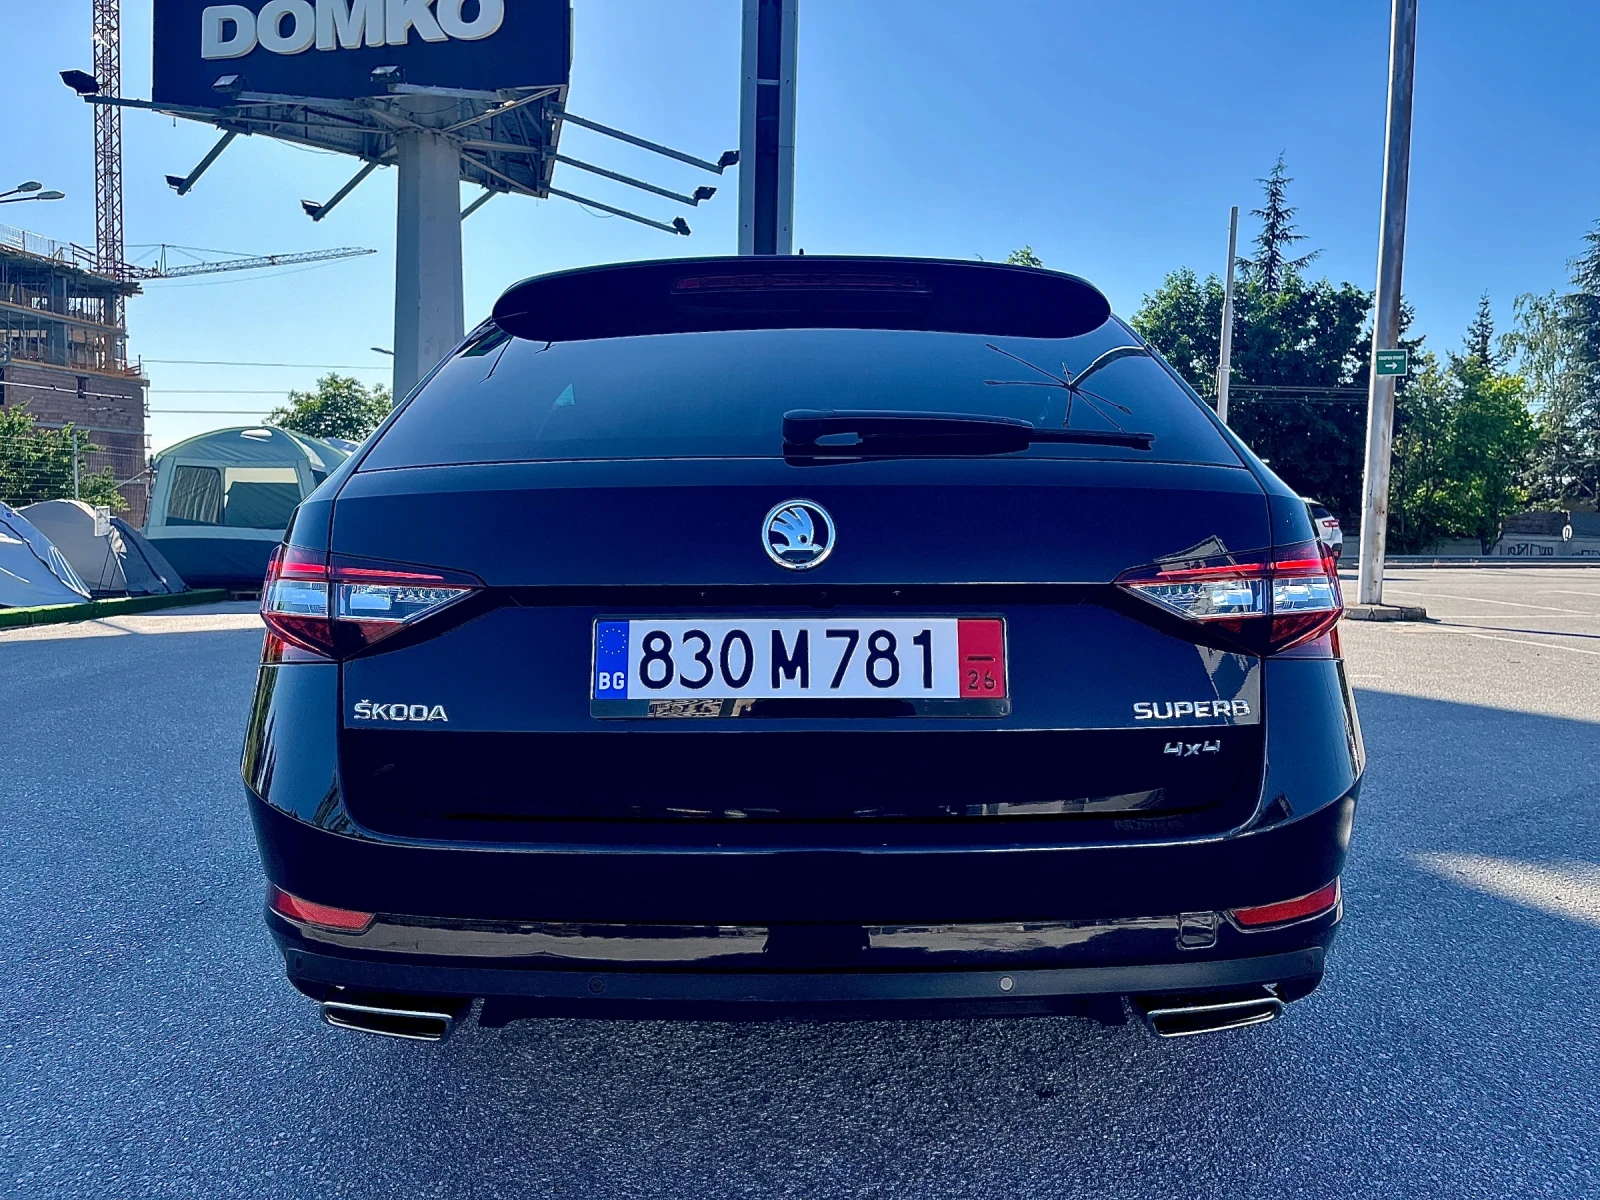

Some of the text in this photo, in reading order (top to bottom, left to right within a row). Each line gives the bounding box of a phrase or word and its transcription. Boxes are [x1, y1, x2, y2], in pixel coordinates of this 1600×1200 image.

[201, 0, 505, 59] DOMKO
[638, 628, 934, 691] 830 M 781
[598, 671, 625, 690] BG
[967, 669, 996, 691] 26
[353, 699, 449, 722] ŠKODA
[1133, 699, 1251, 720] SUPERB
[1163, 739, 1221, 757] 4x4
